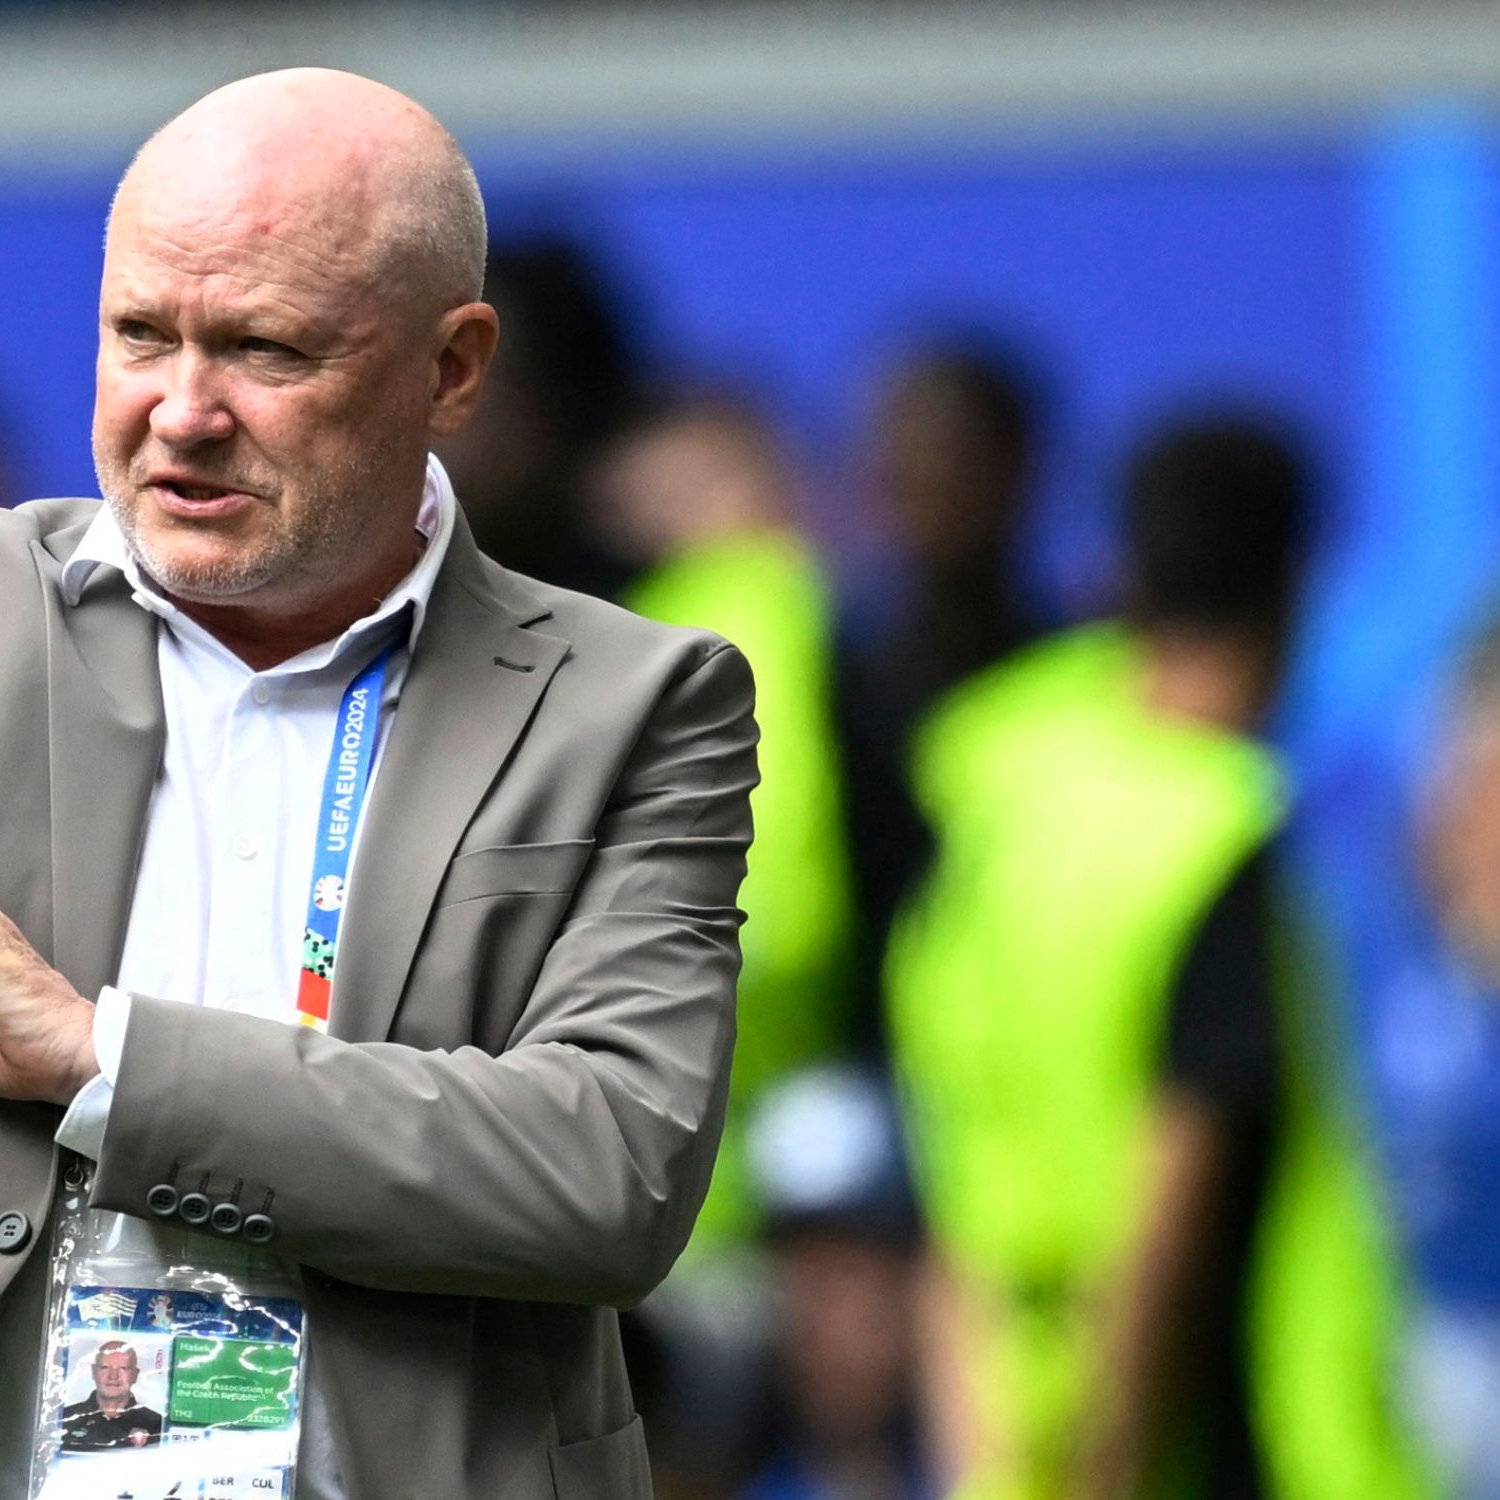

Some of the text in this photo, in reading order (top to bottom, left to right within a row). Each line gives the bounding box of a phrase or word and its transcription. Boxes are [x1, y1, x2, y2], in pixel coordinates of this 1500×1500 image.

[176, 1390, 191, 1398] the
[192, 1390, 220, 1400] Czech
[213, 1383, 263, 1395] Association
[264, 1386, 275, 1395] of
[252, 1477, 275, 1490] CUL
